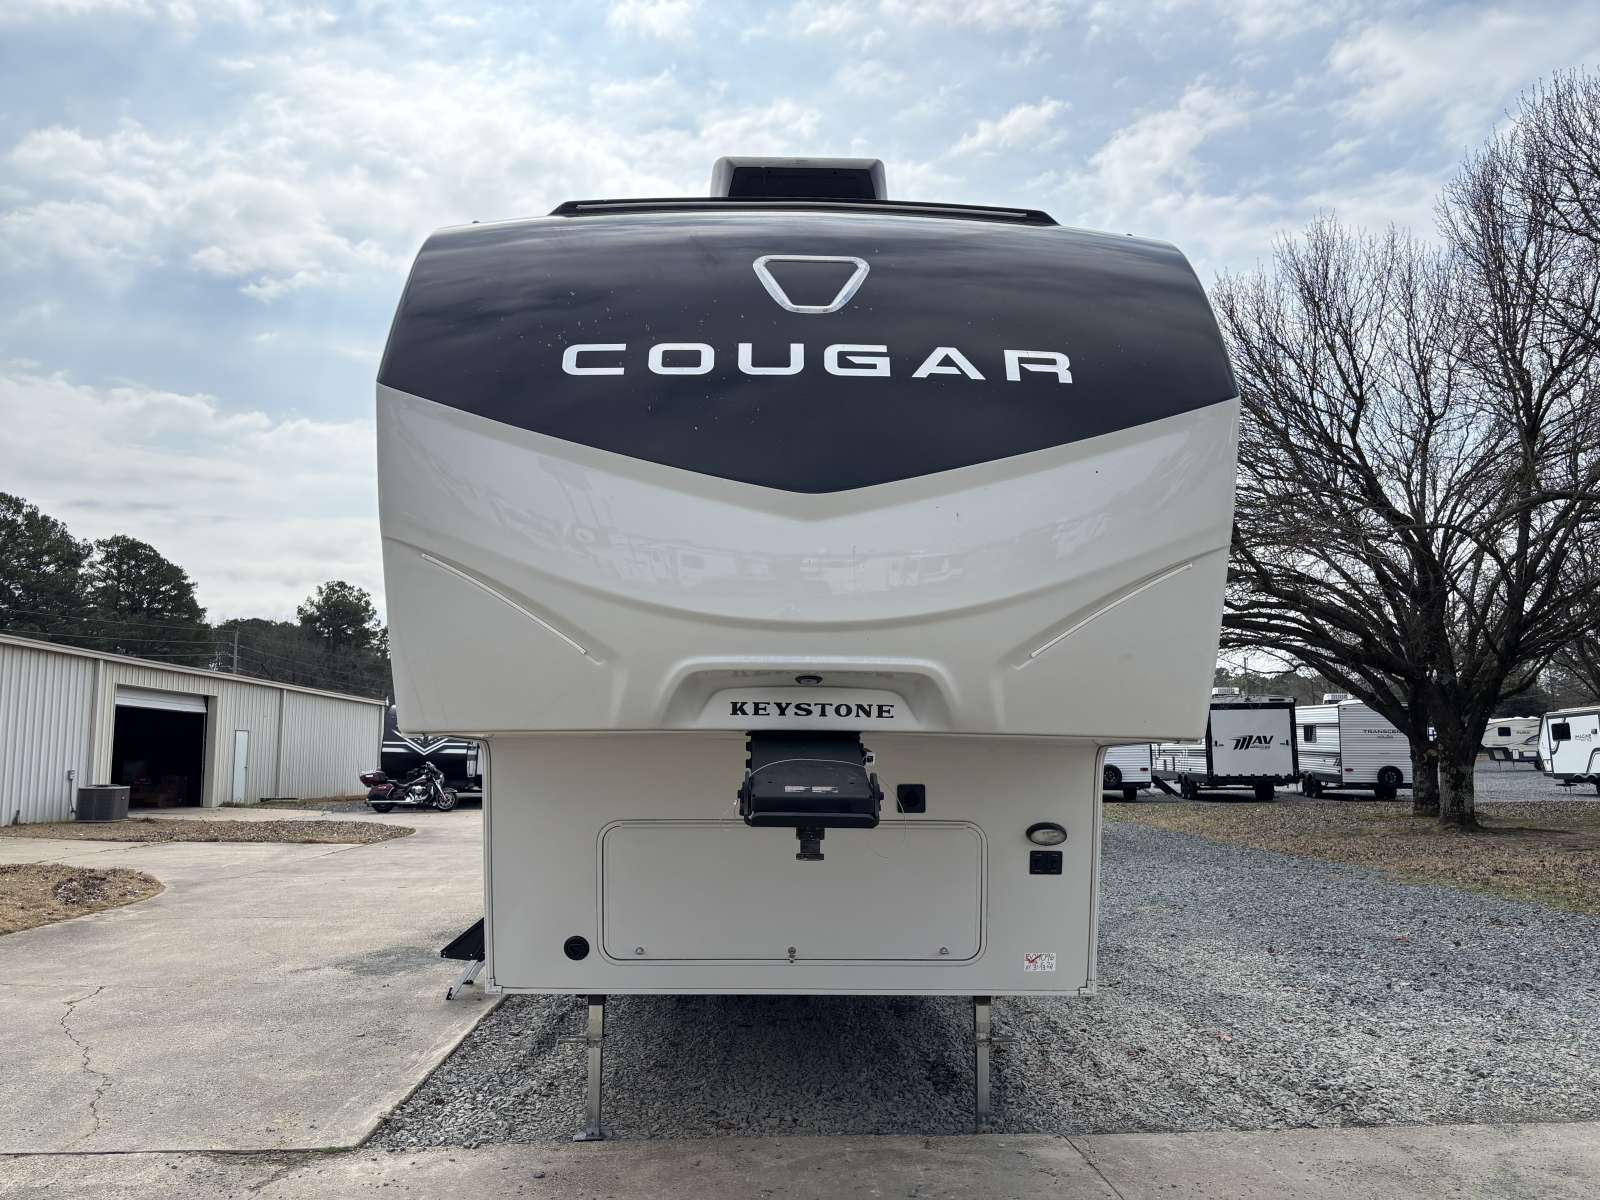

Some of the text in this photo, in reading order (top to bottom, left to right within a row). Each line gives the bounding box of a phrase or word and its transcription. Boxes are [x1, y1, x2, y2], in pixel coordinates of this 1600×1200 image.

[562, 343, 1073, 384] COUGAR
[729, 702, 895, 718] KEYSTONE
[1230, 735, 1274, 750] MAV
